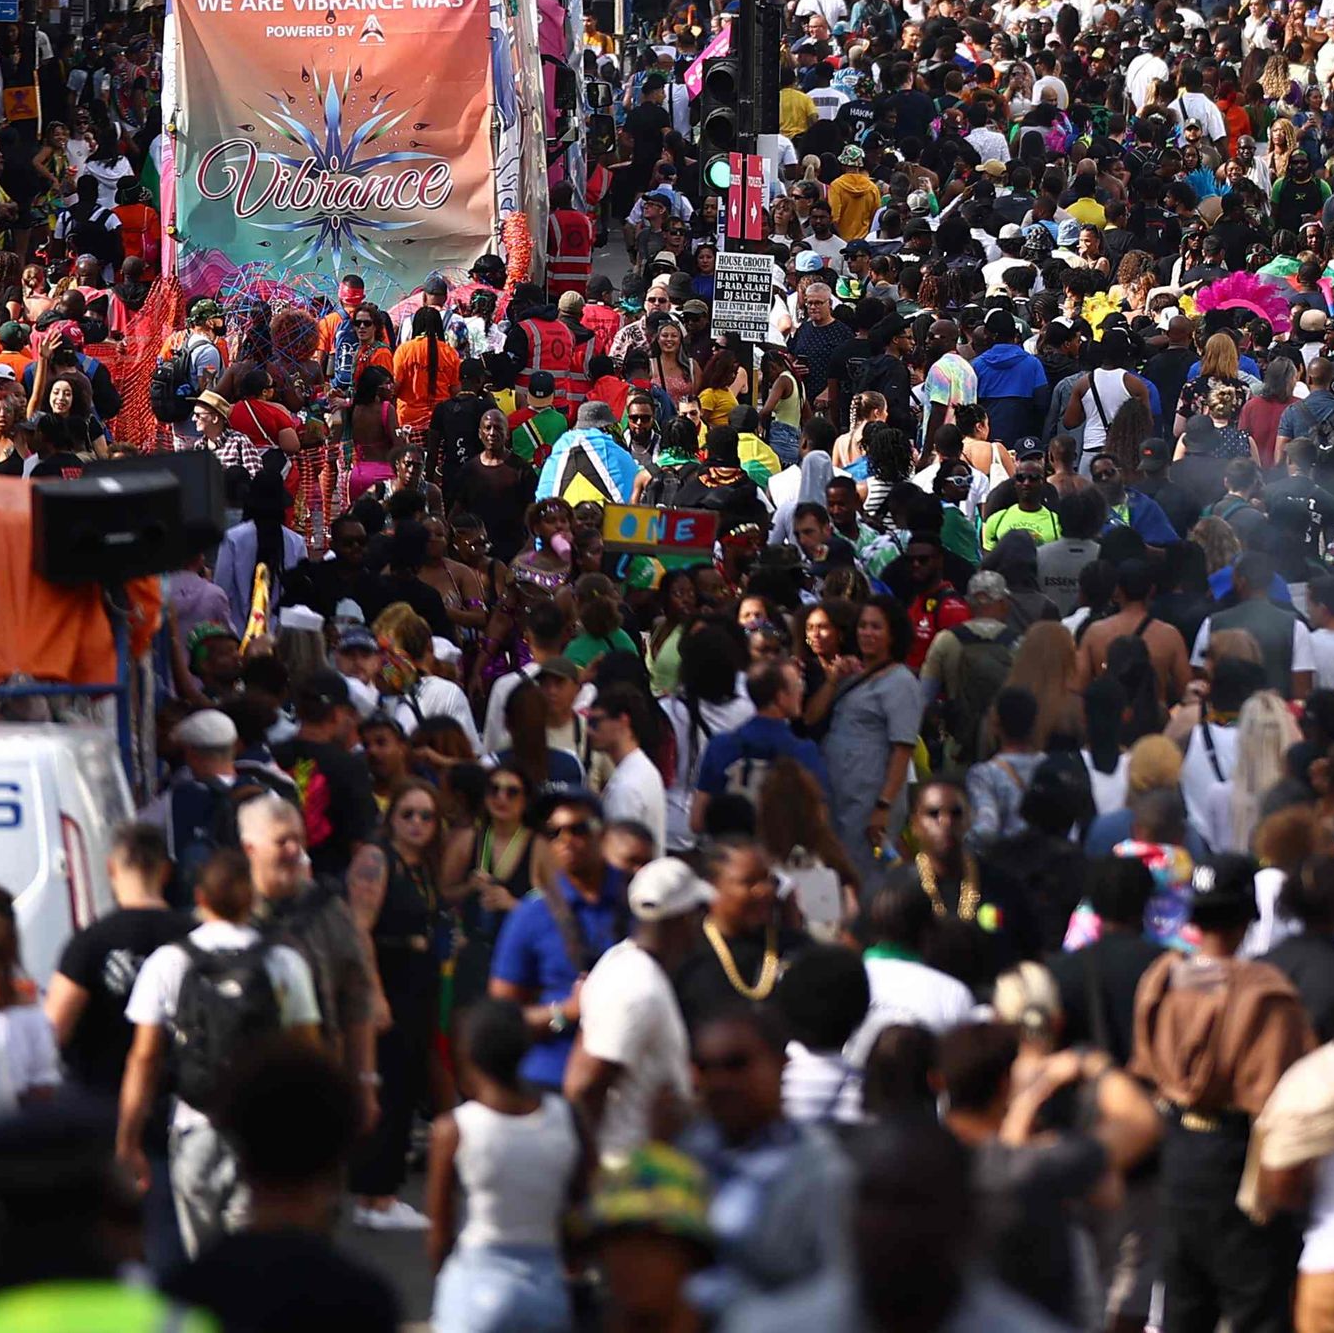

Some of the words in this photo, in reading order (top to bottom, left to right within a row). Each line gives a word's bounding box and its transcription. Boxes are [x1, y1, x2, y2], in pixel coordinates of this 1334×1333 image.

[265, 25, 335, 39] POWERED
[338, 24, 355, 37] BY
[195, 137, 453, 220] Vibrance
[718, 255, 742, 266] HOUSE
[743, 257, 772, 268] GROOVE
[717, 272, 746, 282] HARVY
[746, 274, 770, 283] BRAR
[744, 283, 770, 292] SLAKE
[723, 291, 734, 301] DJ
[618, 512, 696, 541] ONE
[1044, 576, 1078, 587] ESSEN
